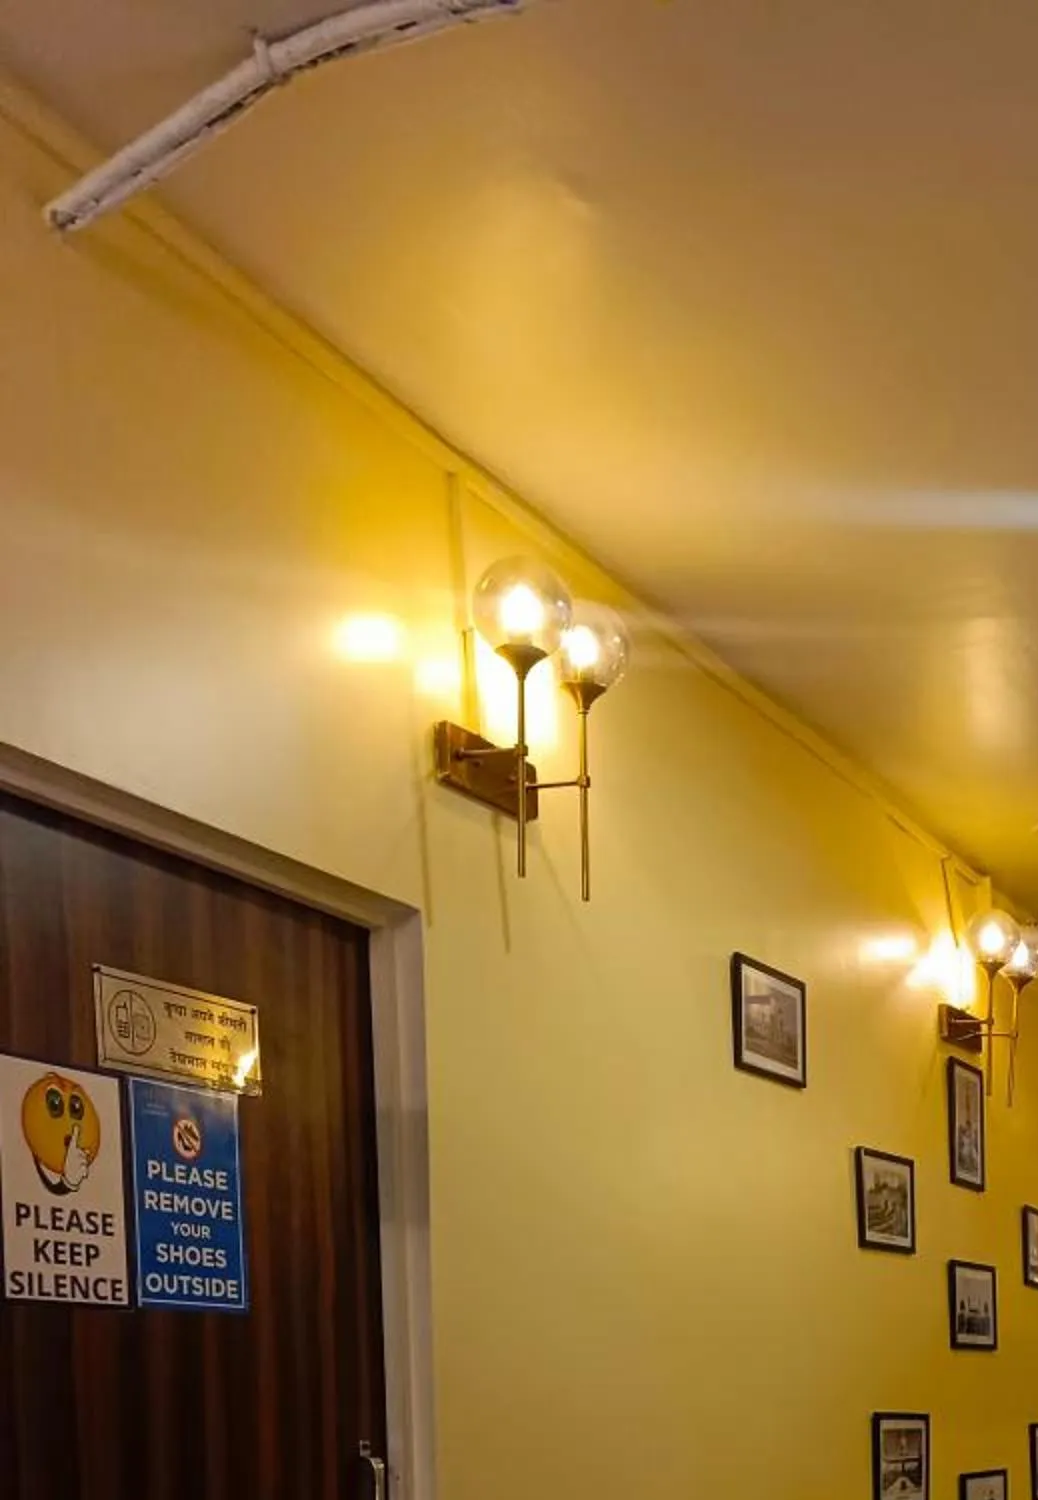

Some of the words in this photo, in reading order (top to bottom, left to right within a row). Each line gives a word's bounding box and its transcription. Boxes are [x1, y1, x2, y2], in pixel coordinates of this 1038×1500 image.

[147, 1159, 228, 1191] PLEASE
[15, 1202, 115, 1237] PLEASE
[144, 1191, 234, 1221] REMOVE
[171, 1221, 212, 1239] YOUR
[33, 1238, 100, 1268] KEEP
[155, 1243, 227, 1268] SHOES
[10, 1270, 123, 1302] SILENCE
[145, 1272, 239, 1299] OUTSIDE
